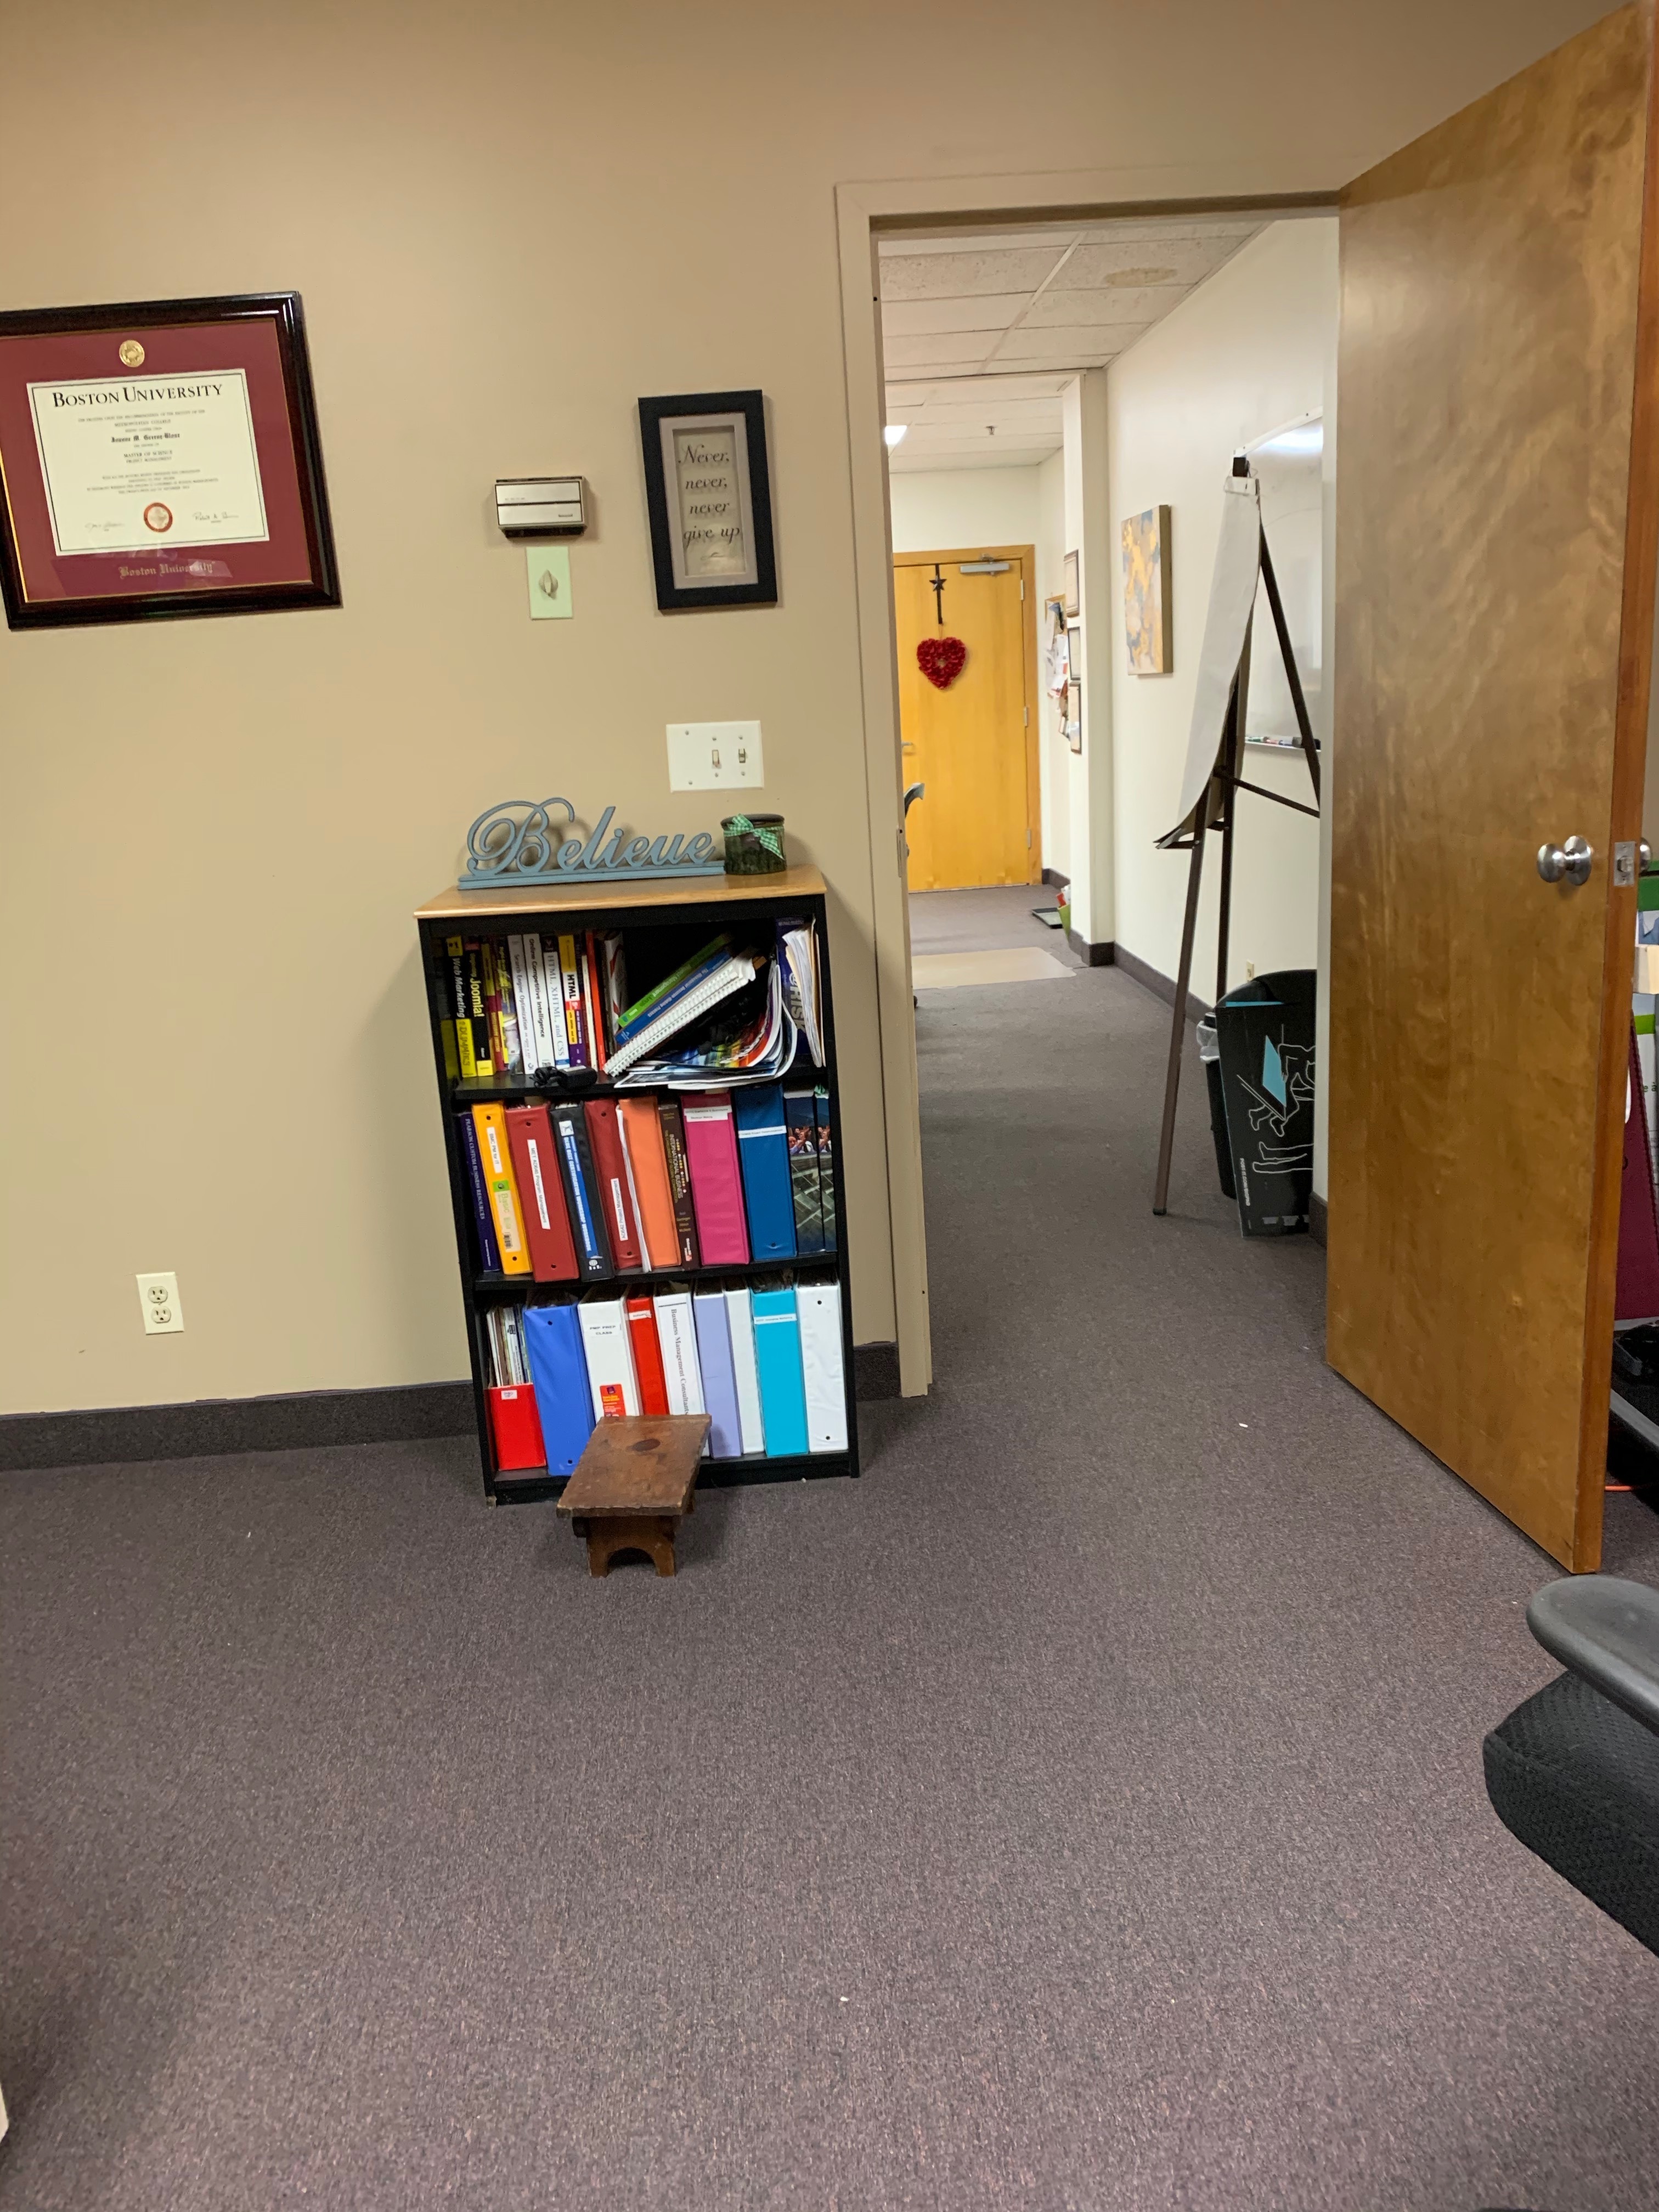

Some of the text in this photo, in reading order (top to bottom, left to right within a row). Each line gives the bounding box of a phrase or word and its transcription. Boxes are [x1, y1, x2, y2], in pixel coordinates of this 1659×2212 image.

[52, 384, 222, 408] BOSTON UNIVERSITY
[678, 444, 730, 464] Never,
[685, 478, 727, 491] never,
[689, 501, 730, 515] never
[684, 525, 740, 548] give up
[119, 566, 156, 579] Boston
[466, 797, 715, 876] Believe
[452, 958, 462, 976] Web
[455, 973, 466, 1018] Marketing
[470, 978, 486, 1018] Joomla!
[531, 961, 540, 1001] Competitive
[536, 1000, 545, 1038] Intelligence
[567, 974, 576, 999] HTML
[518, 995, 528, 1031] Optimization
[548, 955, 566, 1057] HTML, XHTML, and CSS
[459, 1025, 471, 1067] DUMMIES
[465, 1118, 473, 1142] PEARSON
[469, 1142, 477, 1165] CUSTOM
[476, 1189, 486, 1220] RESOURCES
[669, 1133, 684, 1199] INTERNATIONAL BUSINESS
[501, 1193, 510, 1213] Basic
[613, 1180, 622, 1208] Management
[538, 1195, 547, 1223] Management
[675, 1336, 685, 1377] Management
